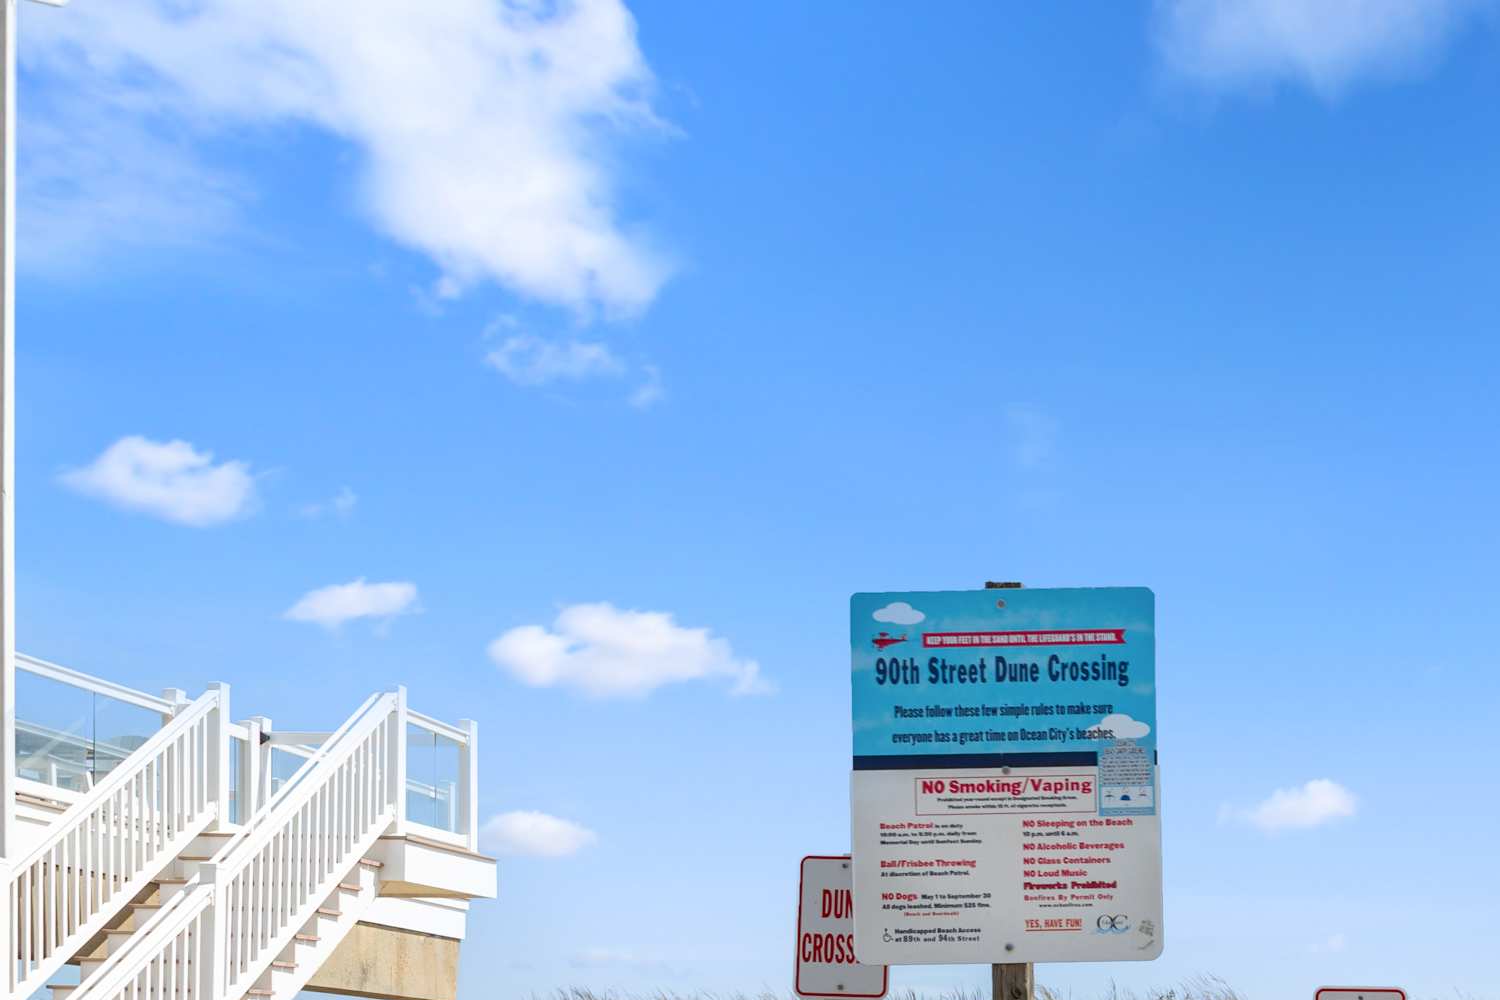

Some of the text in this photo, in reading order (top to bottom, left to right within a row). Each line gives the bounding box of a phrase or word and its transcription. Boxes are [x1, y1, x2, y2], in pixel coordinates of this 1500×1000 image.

[876, 653, 1129, 687] 90th Street Dune Crossing
[894, 701, 1113, 718] Please follow these few simple rules to make sure
[892, 733, 933, 746] everyone
[934, 730, 951, 742] has
[952, 732, 957, 742] a
[959, 731, 983, 745] great
[985, 728, 1006, 741] time
[1008, 731, 1019, 741] on
[1020, 728, 1048, 741] Ocean
[1049, 727, 1075, 743] City's
[922, 777, 1092, 796] NO Smoking/Vaping
[1037, 819, 1075, 828] Sleeping
[1105, 818, 1133, 826] Beach
[1037, 842, 1077, 850] Alcoholic
[1079, 842, 1125, 851] Beverages
[880, 859, 977, 868] Ball/Frisbee Throwing
[1063, 856, 1111, 864] Containers
[1061, 869, 1087, 877] Music
[1024, 880, 1117, 890] Fireworks Prohibited
[896, 892, 918, 902] Dogs
[1097, 893, 1113, 901] Only
[822, 888, 853, 919] DUN
[1025, 918, 1083, 929] YES, HAVE FUN!
[802, 932, 859, 964] CROSS
